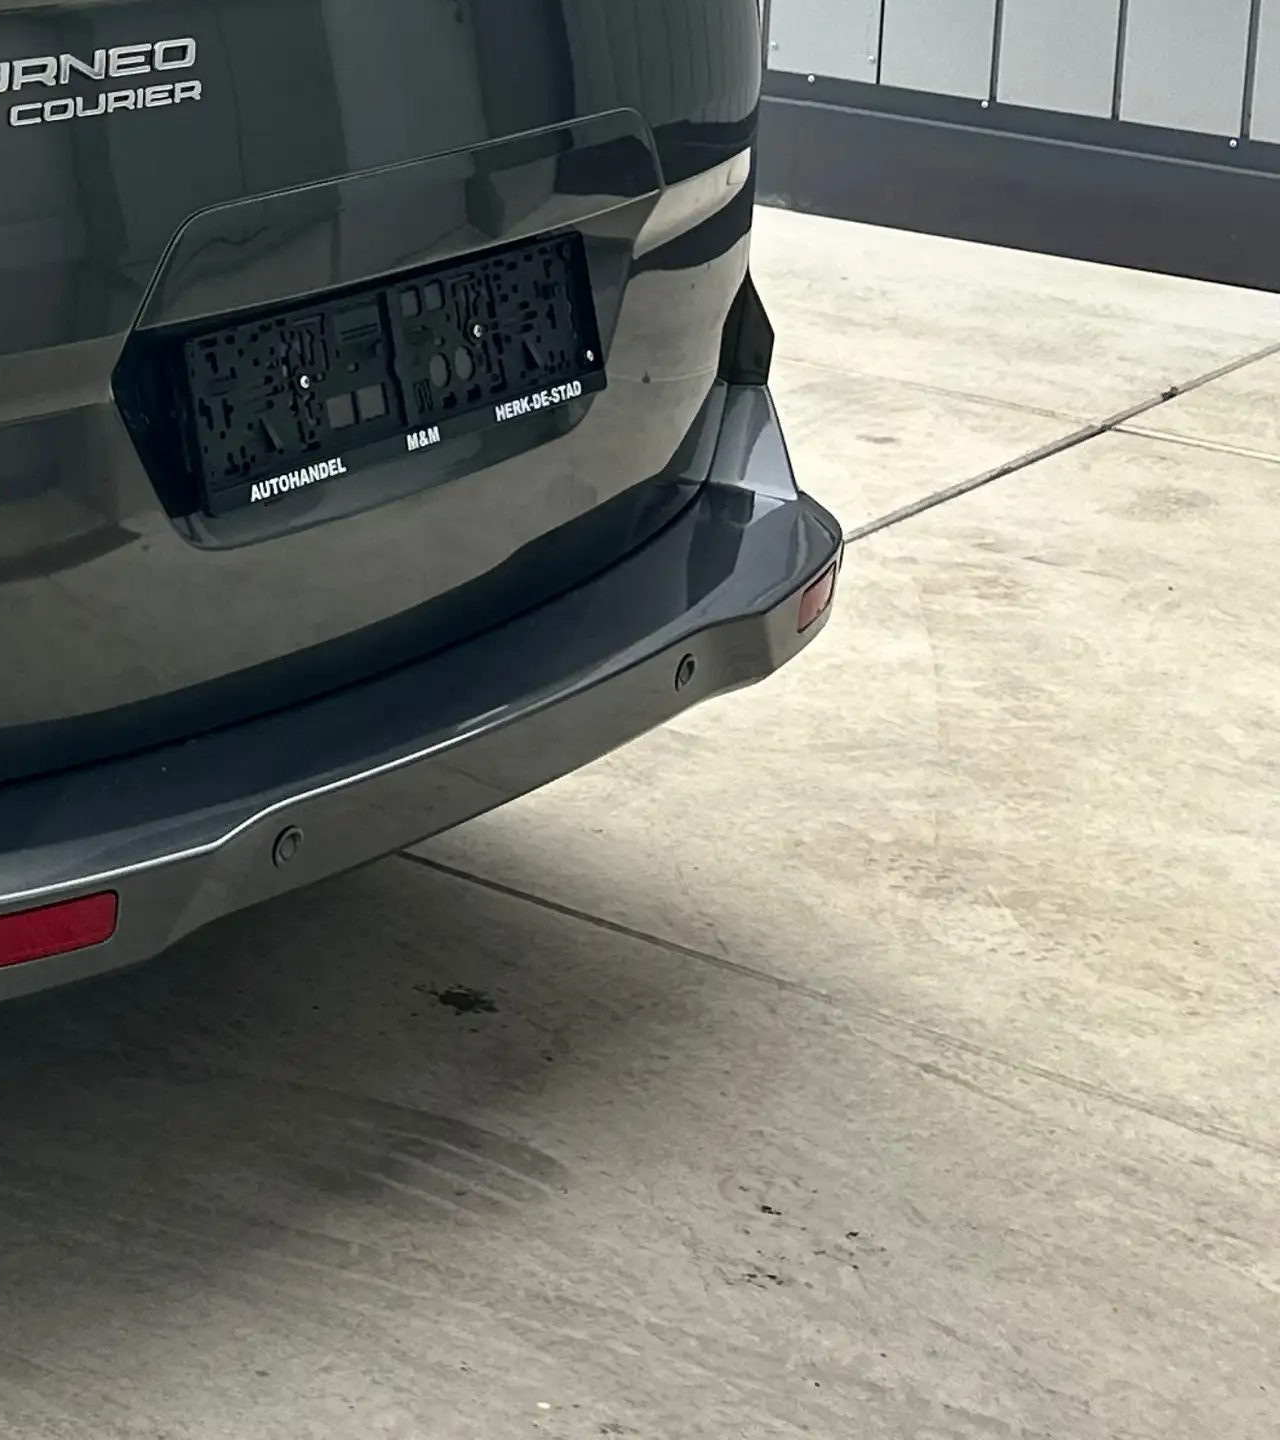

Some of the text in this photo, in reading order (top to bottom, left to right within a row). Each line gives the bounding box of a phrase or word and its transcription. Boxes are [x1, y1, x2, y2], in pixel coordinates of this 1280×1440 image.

[8, 80, 202, 127] COURIER
[249, 380, 583, 503] AUTOHANDEL M&M HERK-DE-STAD
